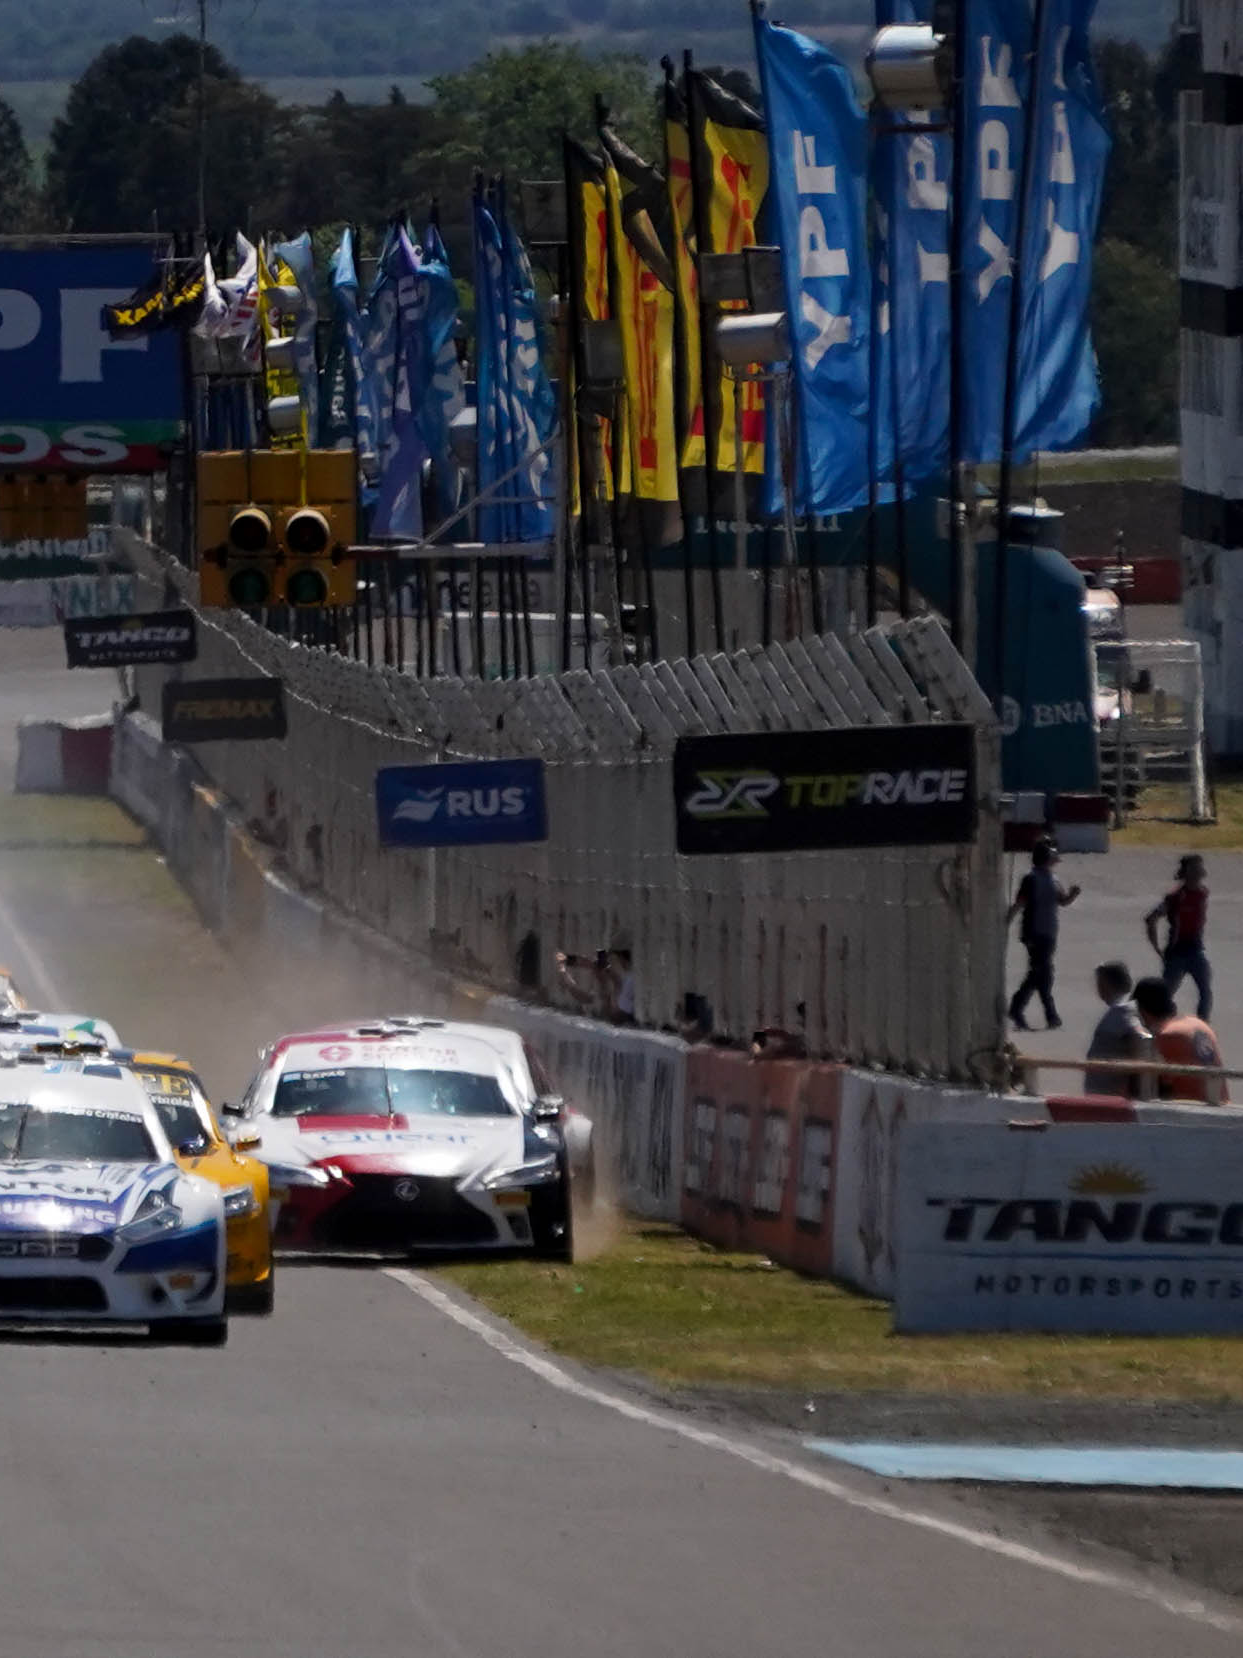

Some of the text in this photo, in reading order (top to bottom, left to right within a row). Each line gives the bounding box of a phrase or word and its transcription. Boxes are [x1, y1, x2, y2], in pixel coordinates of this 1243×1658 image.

[793, 129, 852, 373] YPF
[1033, 701, 1088, 727] BNA
[446, 787, 525, 816] RUS
[975, 1275, 1243, 1299] MOTORSPORTS
